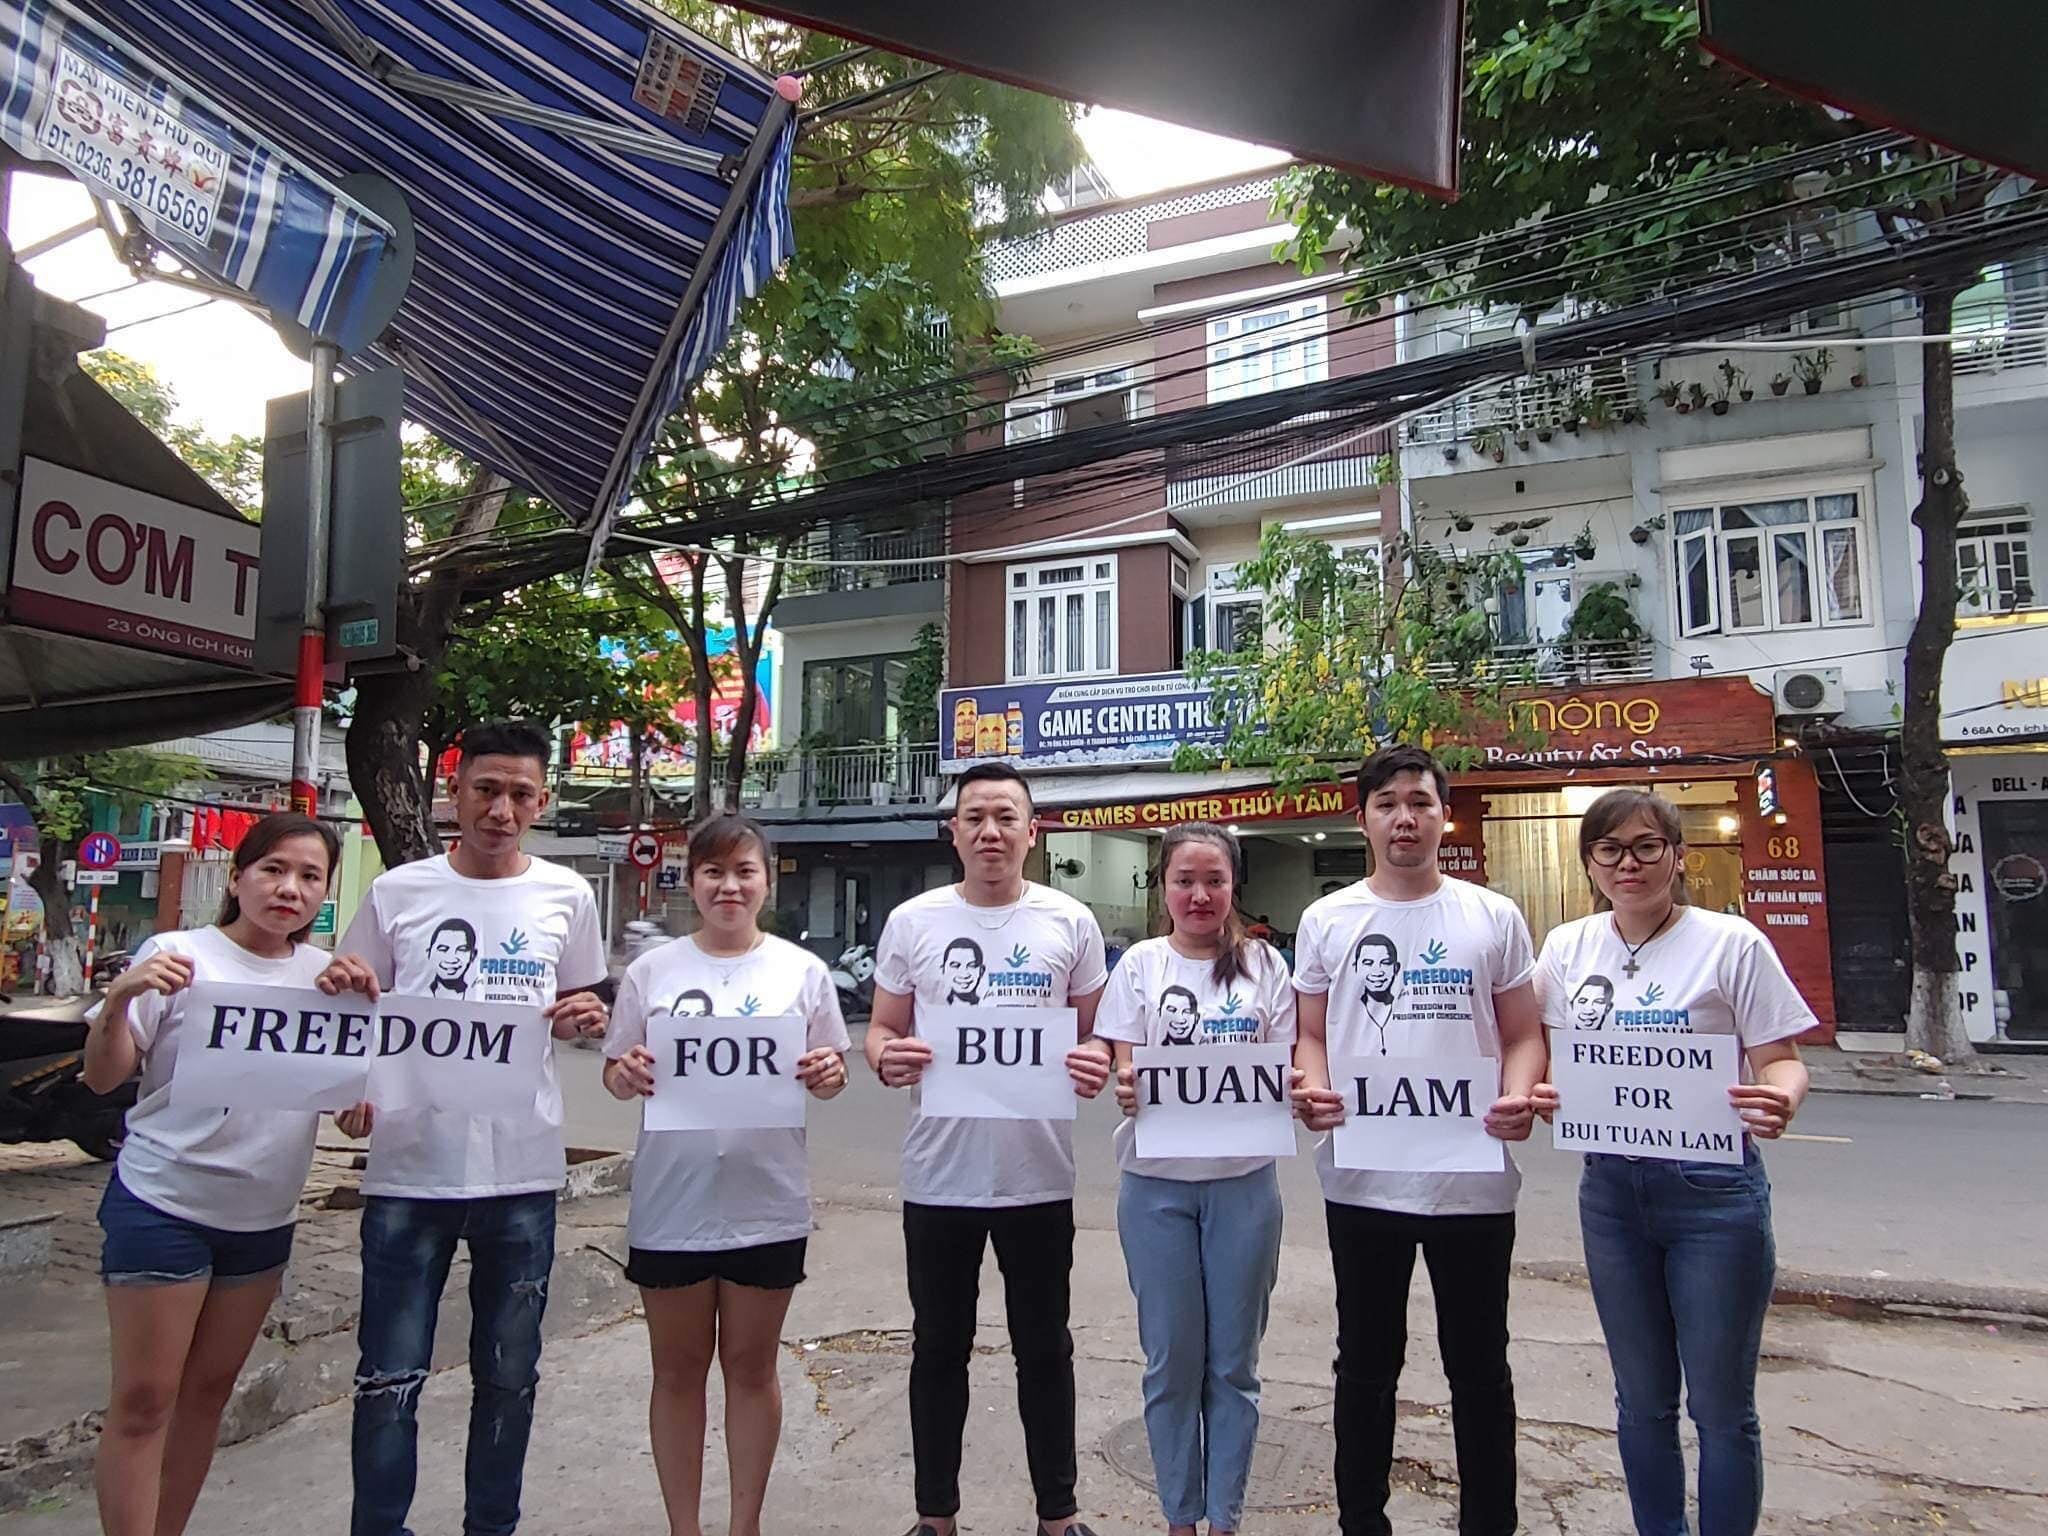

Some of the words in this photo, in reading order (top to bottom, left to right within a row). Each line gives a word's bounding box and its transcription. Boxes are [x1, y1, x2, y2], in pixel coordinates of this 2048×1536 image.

[116, 157, 209, 236] 3816569
[32, 500, 195, 604] CƠM
[107, 617, 130, 633] 23
[136, 623, 181, 644] ÔNG
[1038, 707, 1093, 738] GAME
[1097, 702, 1172, 734] CENTER
[1971, 725, 1994, 735] 68A
[1991, 777, 2028, 793] DELL
[1062, 804, 1137, 828] GAMES
[1141, 798, 1223, 822] CENTER
[1228, 790, 1287, 818] THÚY
[1293, 787, 1344, 814] TÂM
[1767, 836, 1800, 859] 68
[1765, 913, 1809, 926] WAXING
[487, 976, 505, 986] BUI
[988, 971, 1053, 988] FREEDOM
[1403, 967, 1473, 986] FREEDOM
[997, 987, 1013, 998] BUI
[1015, 987, 1038, 998] TUAN
[1412, 986, 1429, 996] BUI
[1431, 985, 1457, 996] TUAN
[1393, 1012, 1426, 1021] PRISONER
[1426, 1011, 1435, 1020] OF
[1412, 1002, 1443, 1011] FREEDOM
[1444, 1003, 1457, 1011] FOR
[1614, 1008, 1689, 1026] FREEDOM
[206, 1004, 517, 1065] FREEDOM
[956, 1026, 1045, 1067] BUI
[673, 1036, 781, 1077] FOR
[1572, 1042, 1714, 1070] FREEDOM
[1138, 1063, 1286, 1105] TUAN
[1353, 1076, 1475, 1118] LAM
[1614, 1086, 1673, 1111] FOR
[1560, 1121, 1600, 1141] BUI
[1605, 1124, 1676, 1149] TUAN
[1681, 1129, 1735, 1153] LAM
